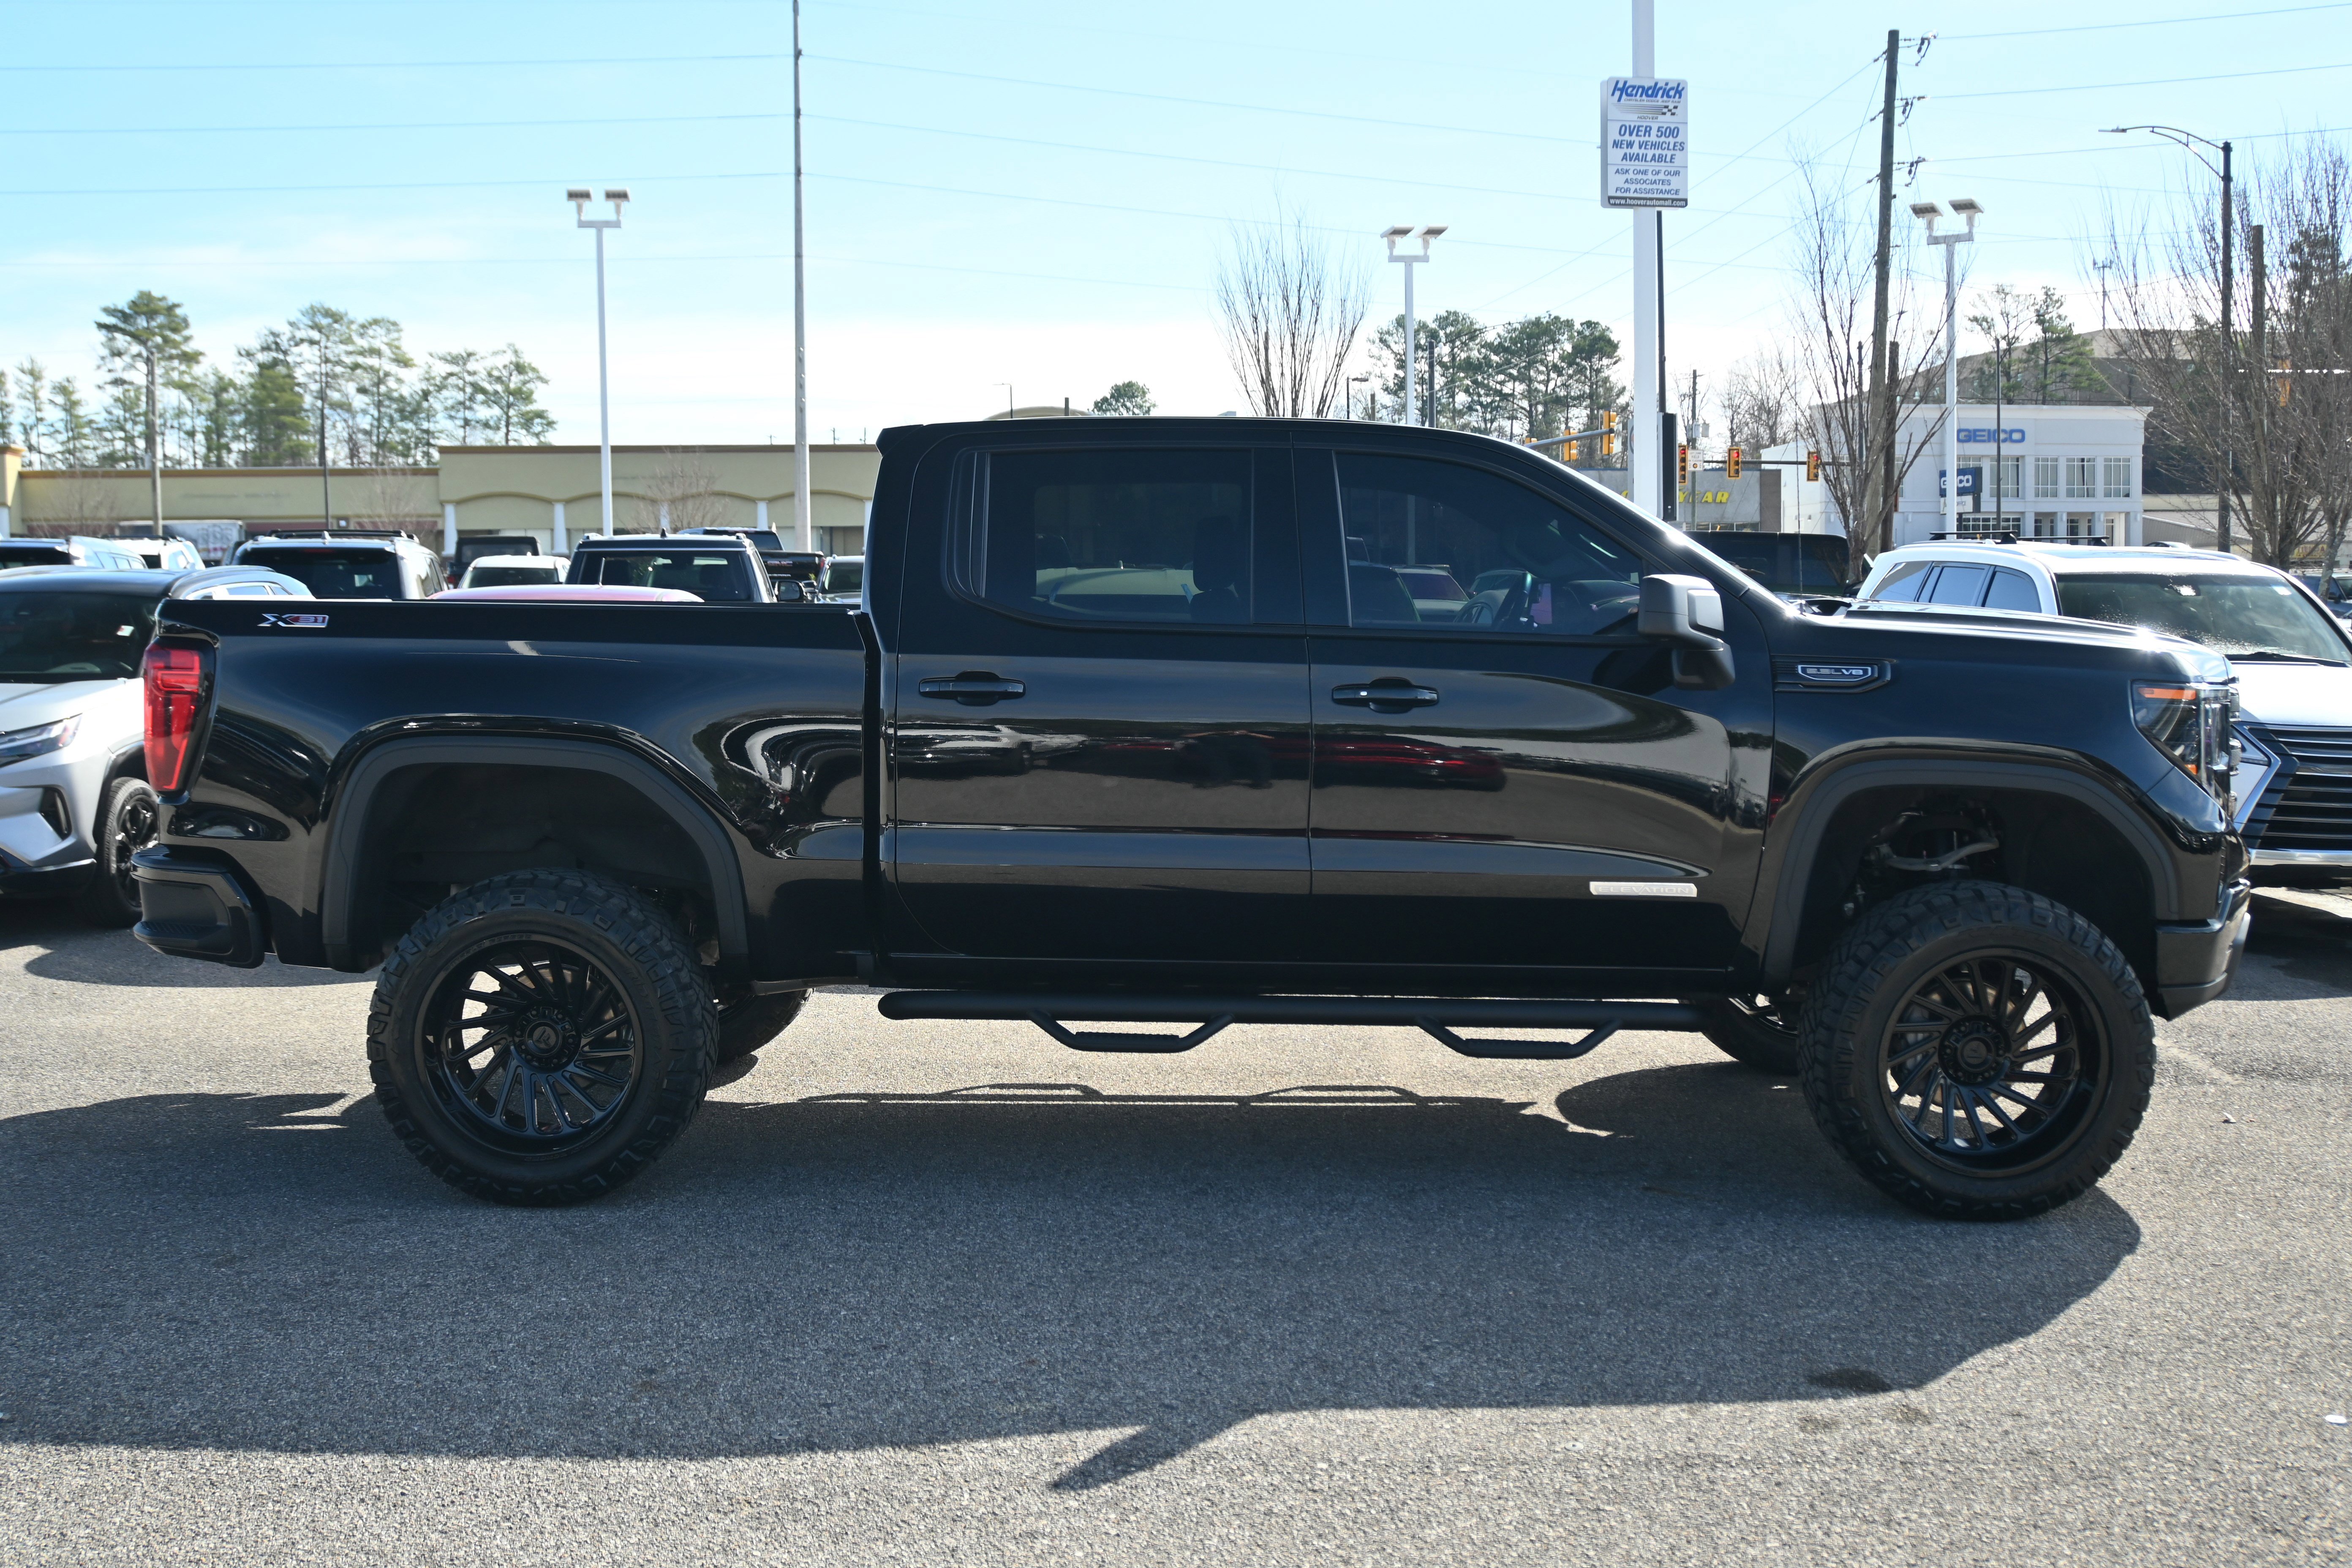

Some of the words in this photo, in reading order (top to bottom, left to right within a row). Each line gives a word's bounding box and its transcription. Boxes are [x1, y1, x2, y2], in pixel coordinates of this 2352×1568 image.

[1611, 80, 1685, 102] Hendrick
[1618, 124, 1652, 138] OVER
[1656, 126, 1680, 139] 500
[1612, 139, 1635, 149] NEW
[1638, 140, 1685, 151] VEHICLES
[1621, 152, 1676, 163] AVAILABLE
[1610, 197, 1685, 207] www.hooverautomall.com
[1957, 428, 2025, 443] GEICO
[1941, 474, 1972, 488] GCO
[257, 613, 329, 628] X31
